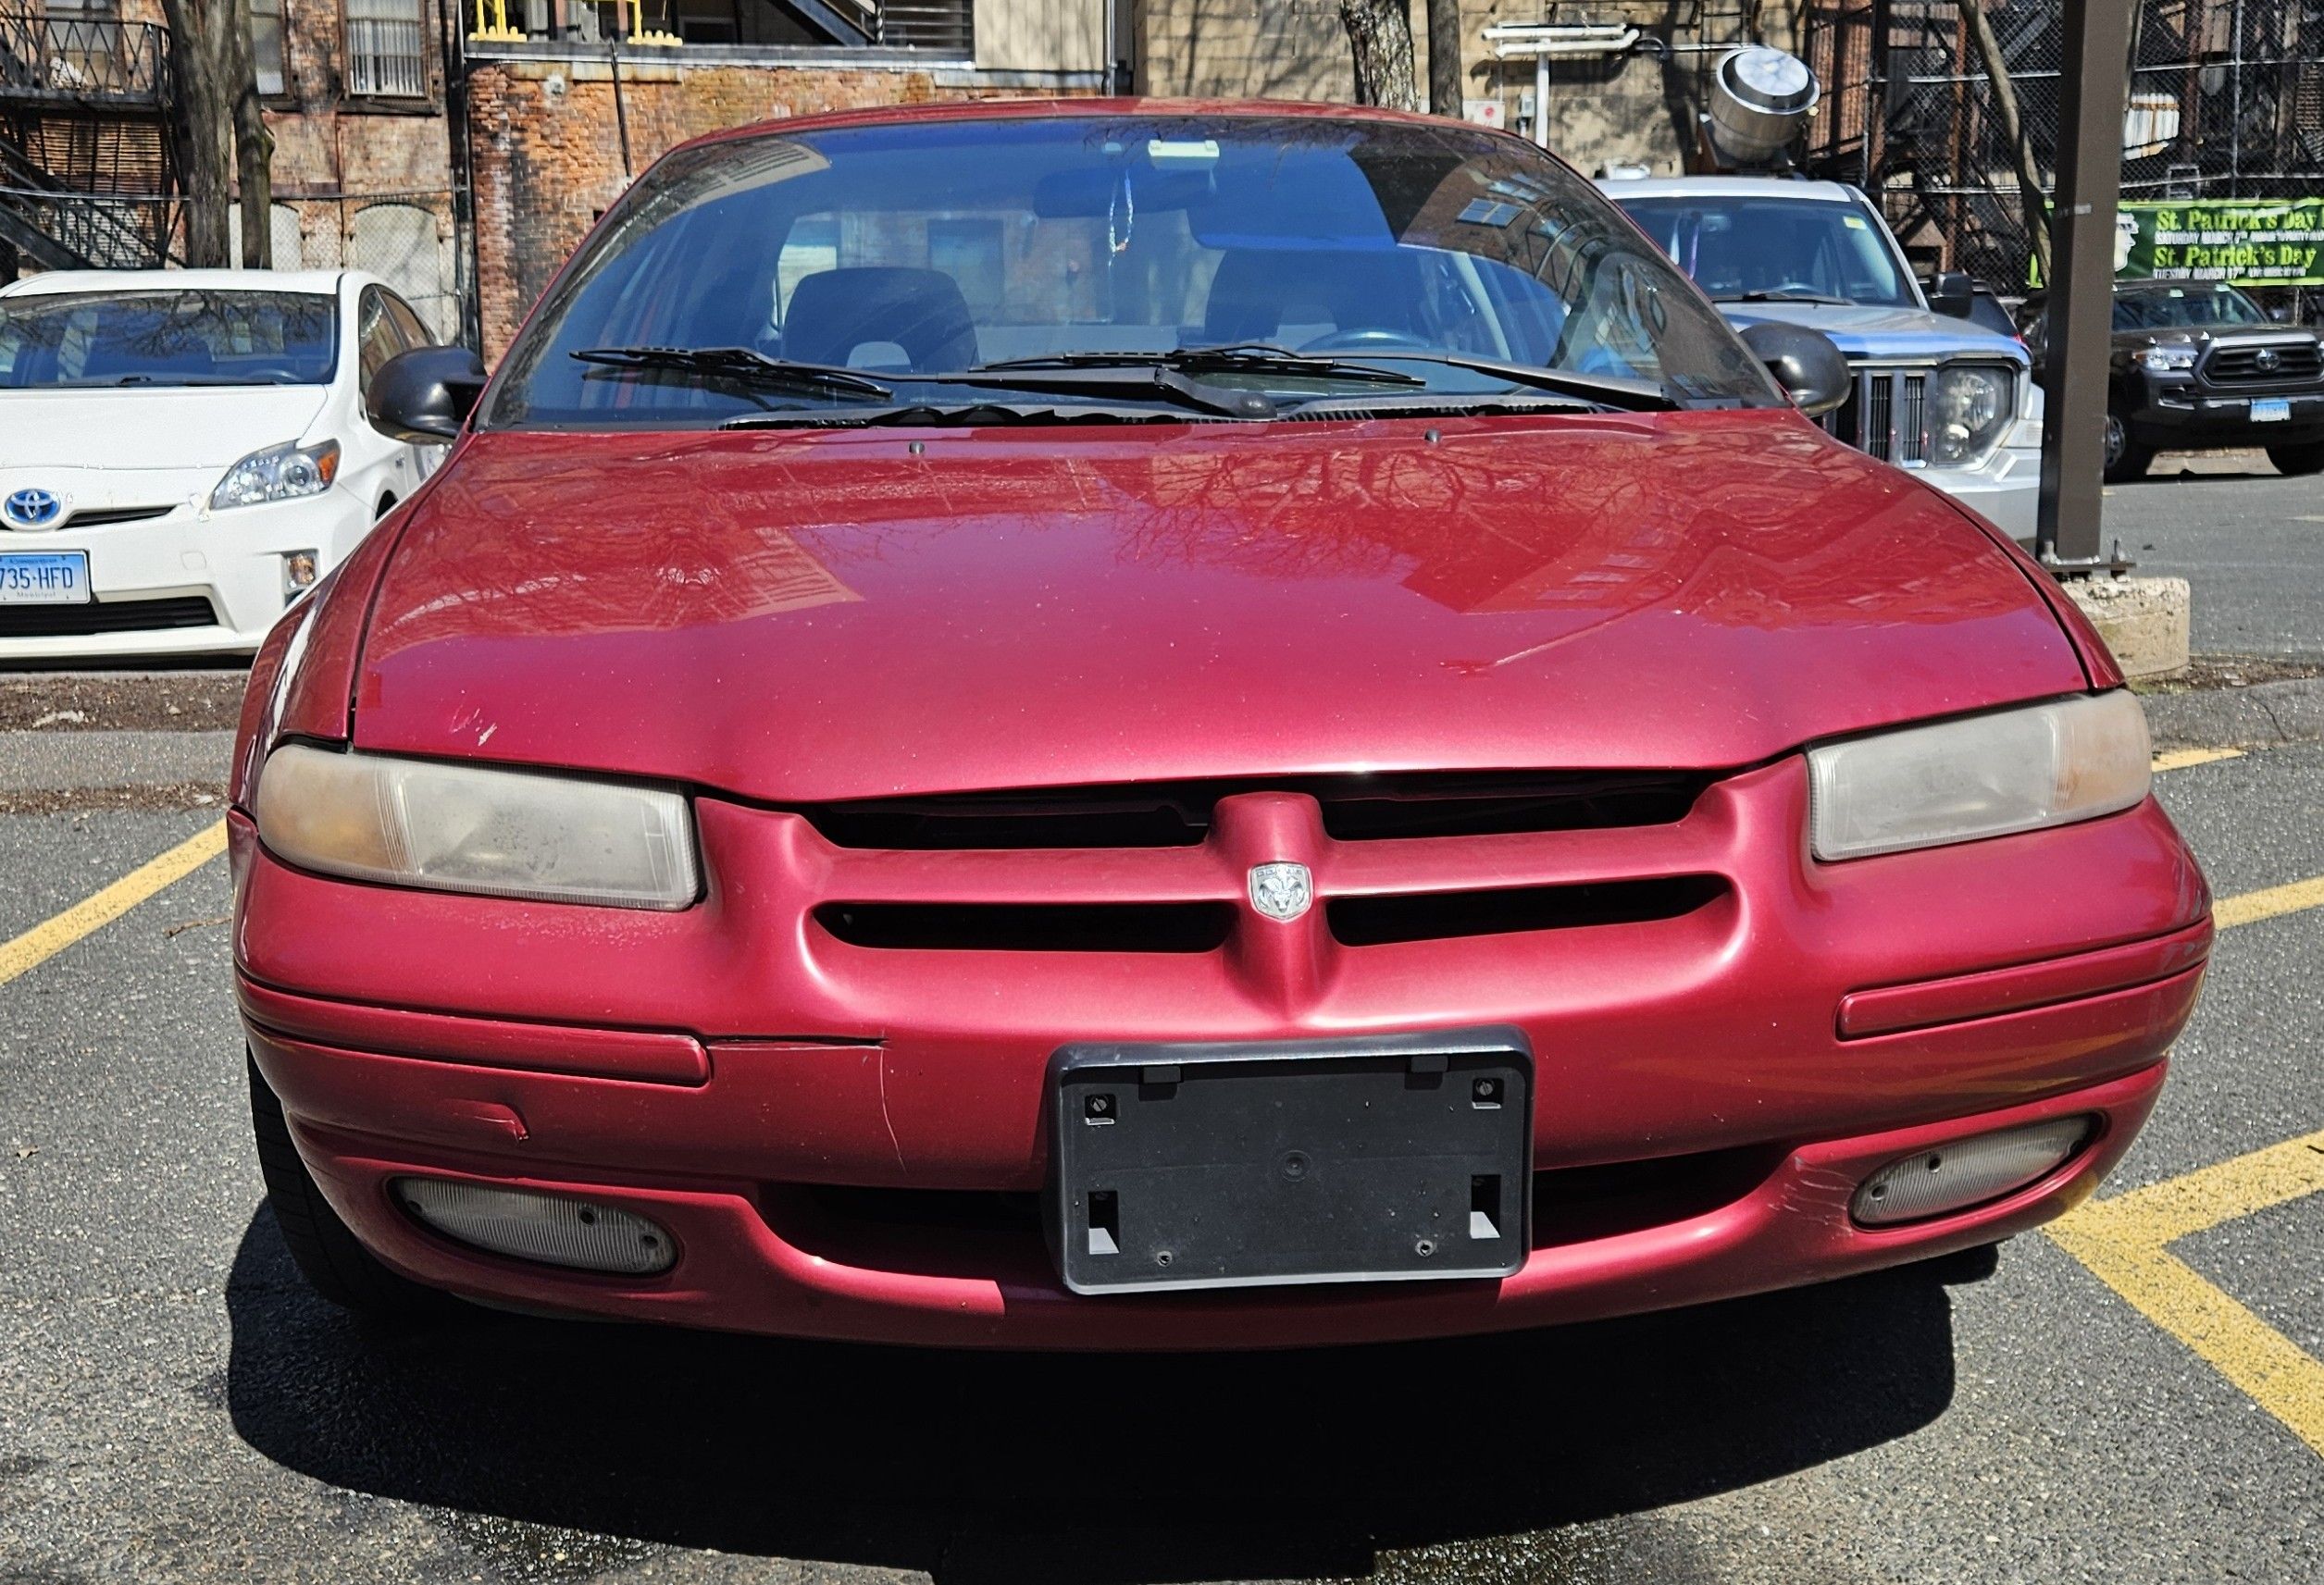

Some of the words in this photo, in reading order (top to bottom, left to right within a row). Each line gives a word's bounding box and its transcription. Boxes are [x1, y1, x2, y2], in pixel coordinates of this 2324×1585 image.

[2156, 208, 2181, 230] St.
[2282, 211, 2318, 232] Day
[2184, 244, 2276, 267] Patrick's
[2281, 244, 2317, 269] Day
